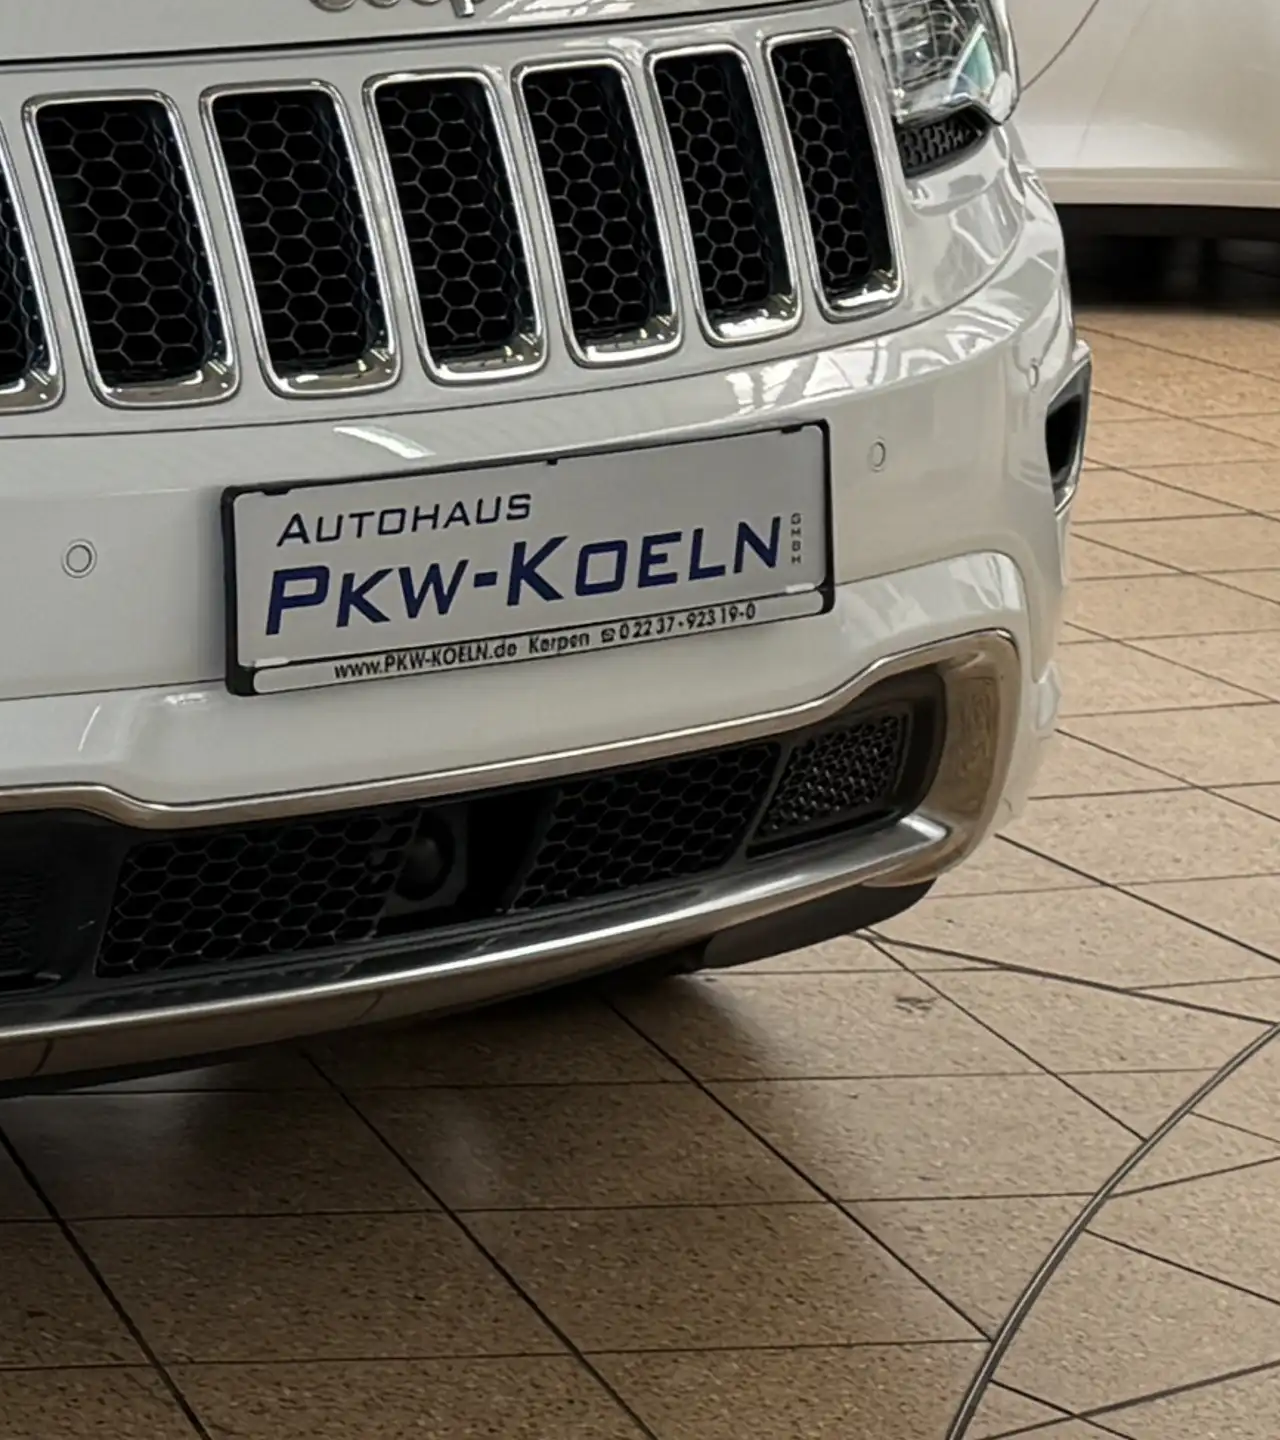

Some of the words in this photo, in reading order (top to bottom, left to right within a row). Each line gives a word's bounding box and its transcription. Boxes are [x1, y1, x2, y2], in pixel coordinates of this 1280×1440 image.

[277, 492, 532, 547] AUTOHAUS
[264, 516, 782, 636] PKW-KOELN
[333, 641, 518, 680] www.PKW-KOELN.de
[528, 631, 591, 657] Kerpen
